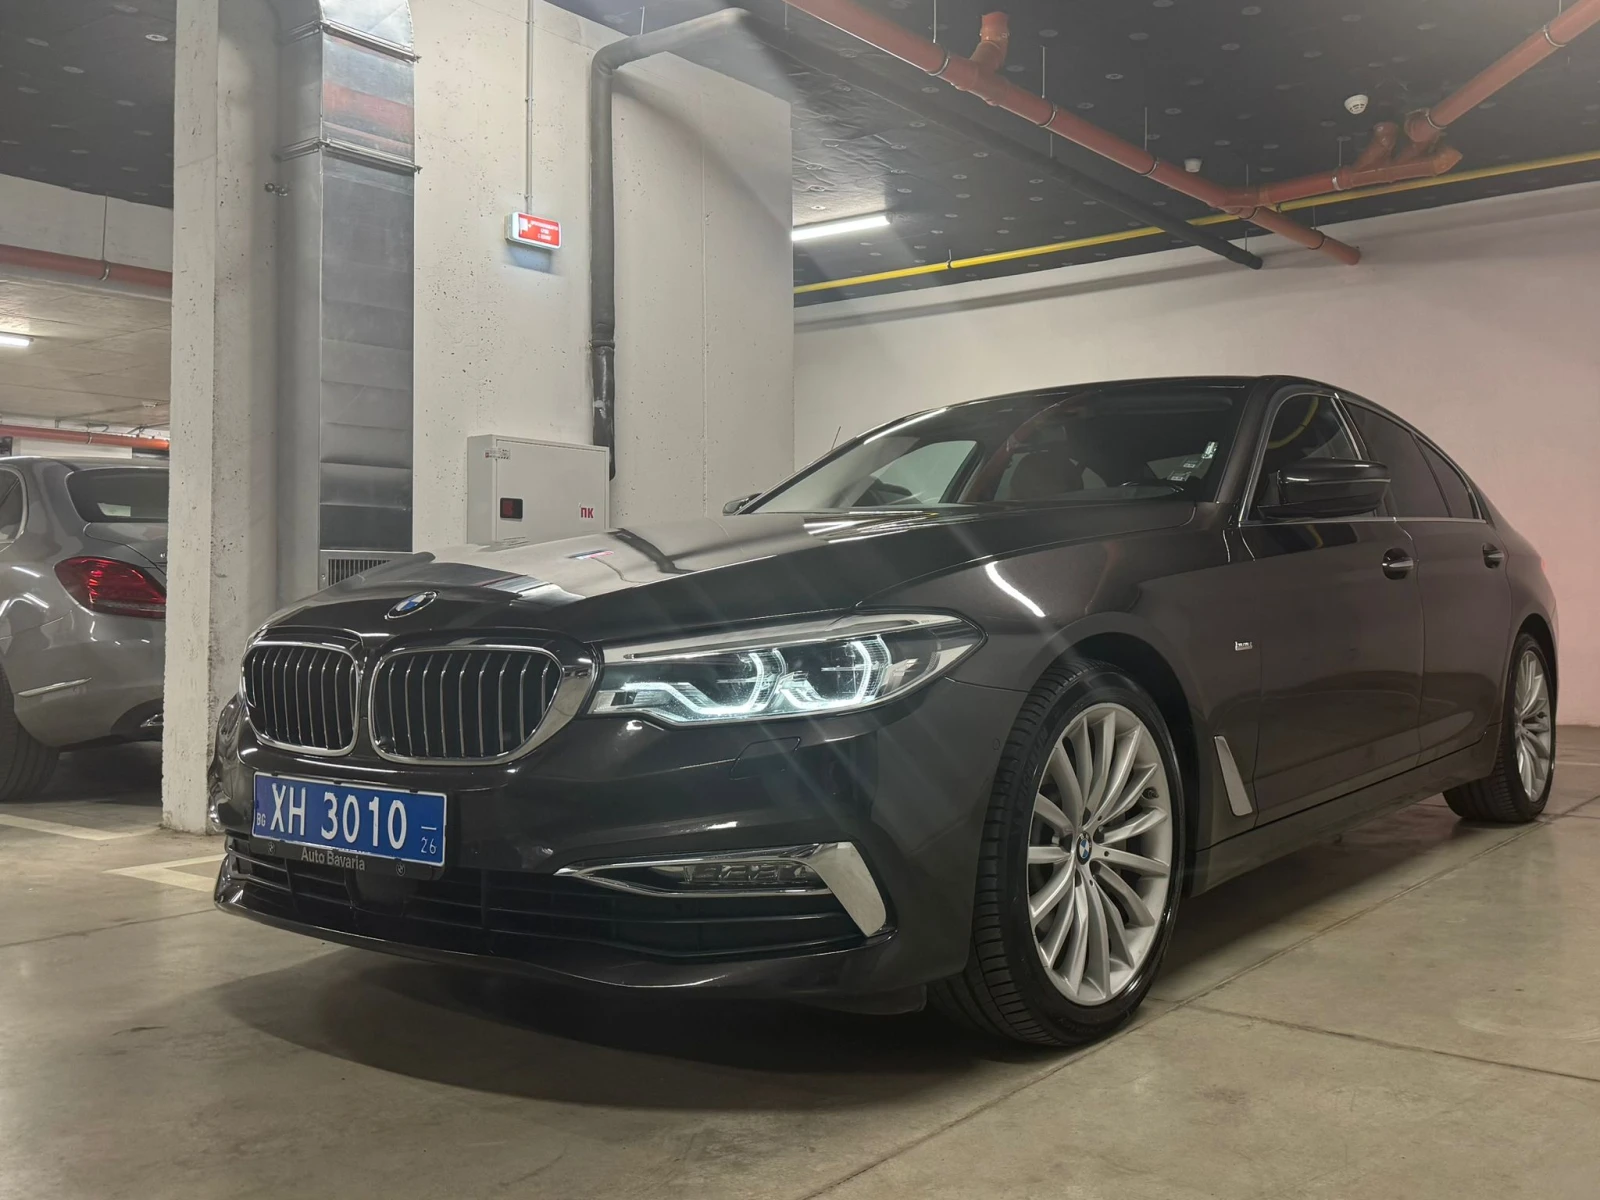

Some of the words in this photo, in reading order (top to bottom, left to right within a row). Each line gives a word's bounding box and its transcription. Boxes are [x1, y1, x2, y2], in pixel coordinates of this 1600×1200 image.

[580, 507, 594, 518] ПК
[256, 812, 266, 827] BG
[270, 783, 306, 836] XH
[321, 792, 408, 849] 3010
[420, 837, 437, 855] 26
[301, 846, 325, 865] Auto
[327, 851, 366, 871] Bavaria
